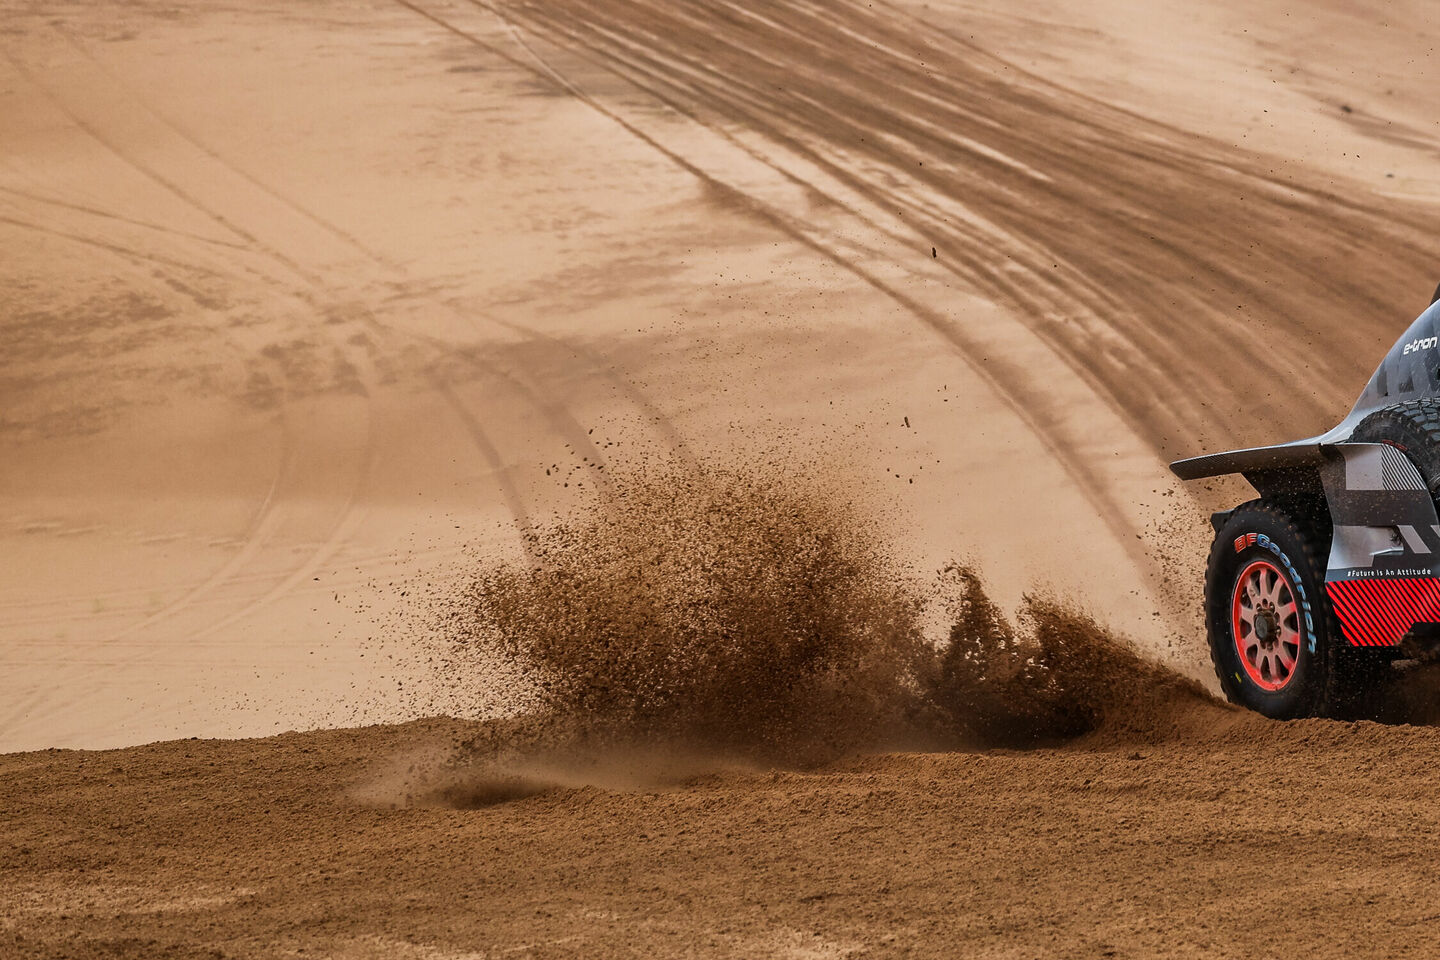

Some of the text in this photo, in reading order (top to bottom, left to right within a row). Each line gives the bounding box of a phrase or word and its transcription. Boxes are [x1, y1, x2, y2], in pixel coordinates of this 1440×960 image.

[1403, 336, 1438, 355] e-tron
[1347, 569, 1375, 578] #Future
[1385, 568, 1395, 576] An
[1397, 567, 1432, 576] Attitude
[1233, 532, 1317, 654] BFGoodrich
